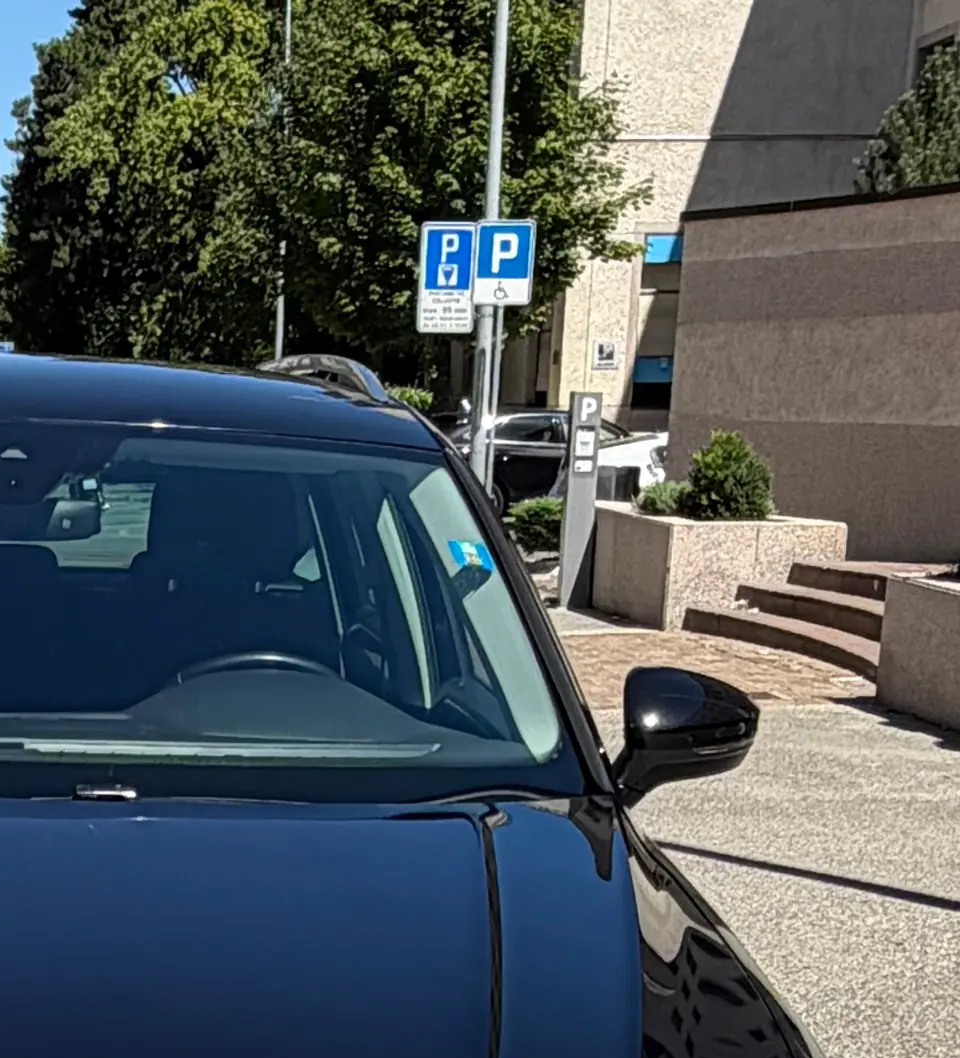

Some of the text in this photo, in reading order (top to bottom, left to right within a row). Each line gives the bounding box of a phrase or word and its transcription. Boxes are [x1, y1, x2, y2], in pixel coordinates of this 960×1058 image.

[441, 233, 459, 264] P
[491, 232, 519, 274] P
[580, 396, 598, 422] P
